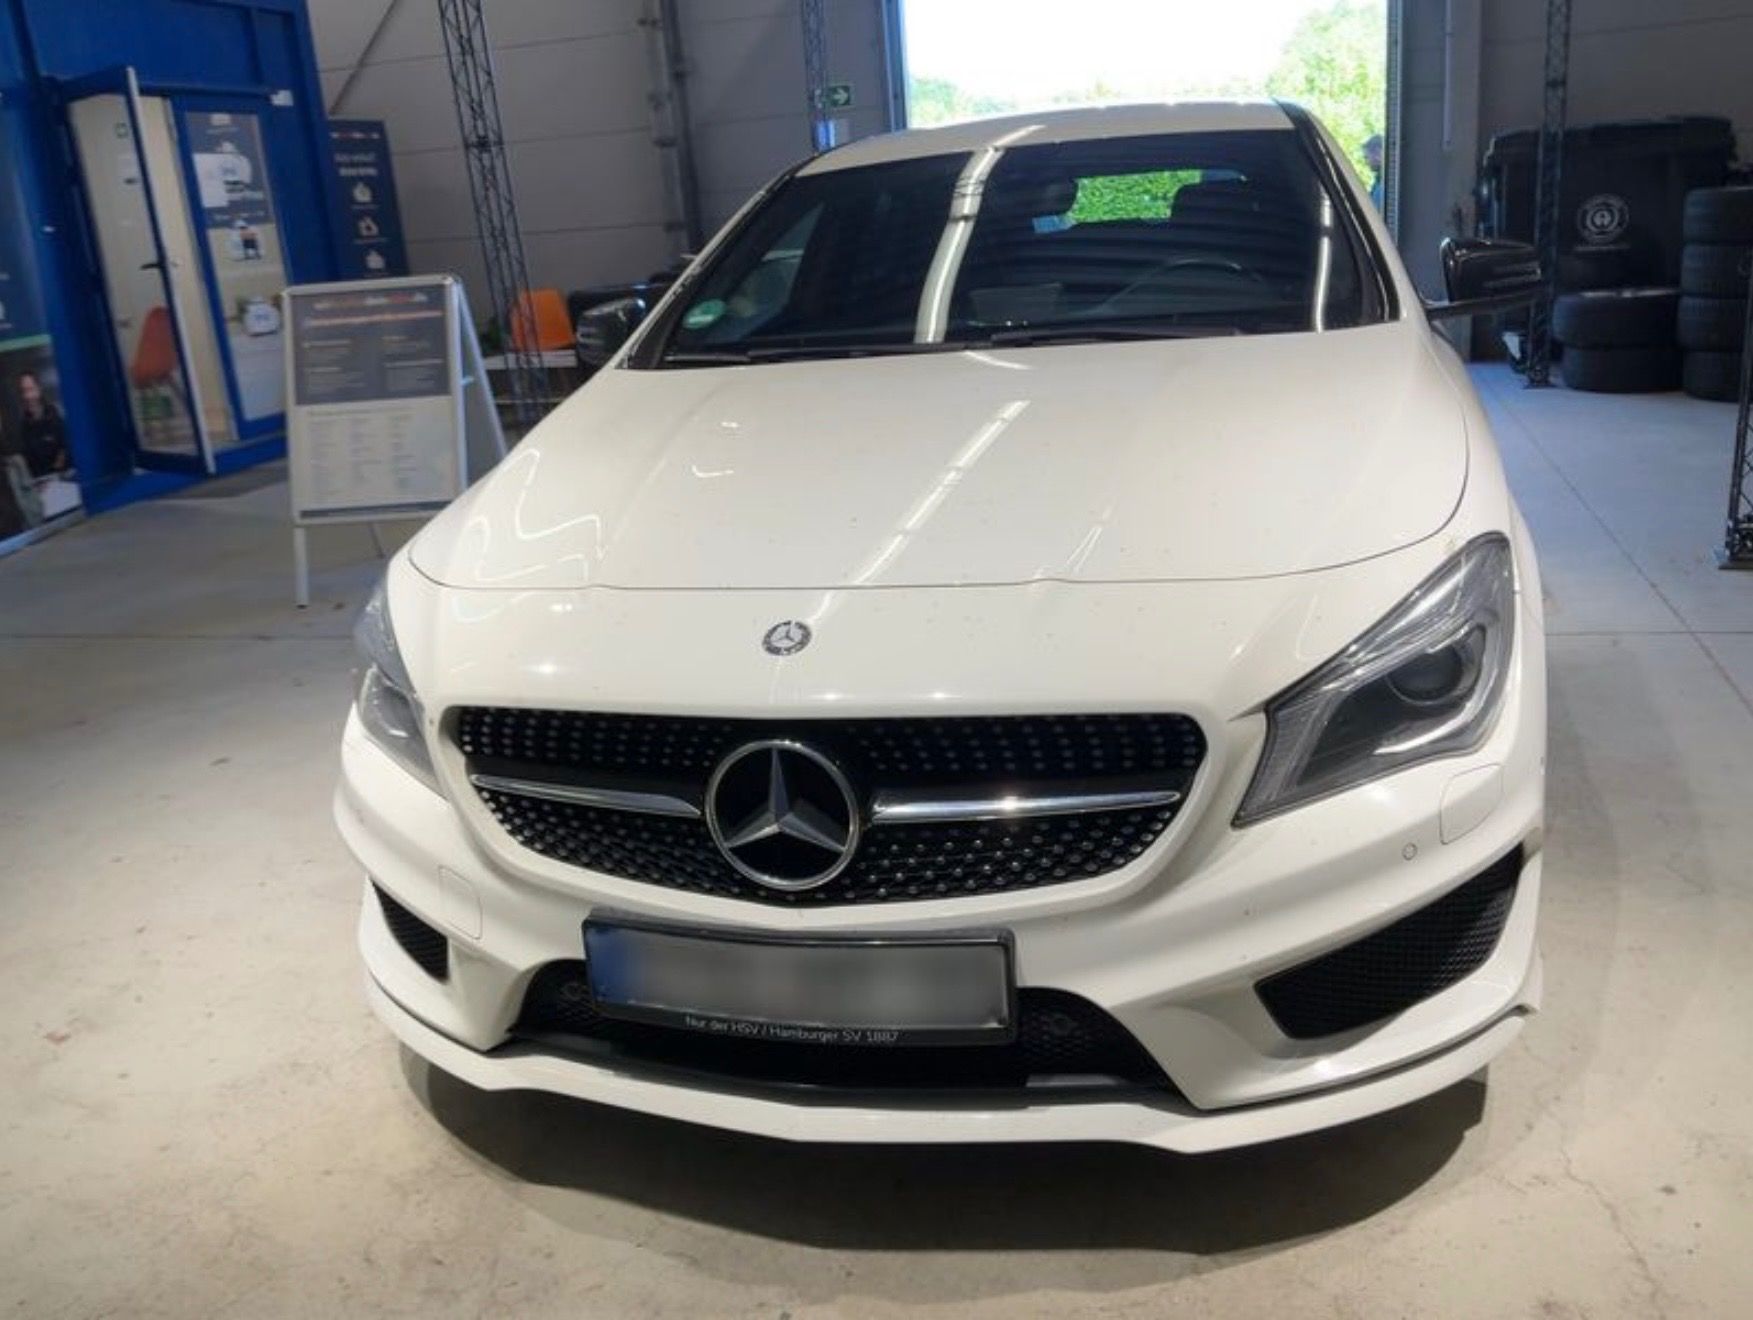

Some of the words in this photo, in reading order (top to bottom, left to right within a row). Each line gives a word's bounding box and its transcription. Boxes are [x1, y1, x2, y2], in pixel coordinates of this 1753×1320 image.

[686, 1015, 706, 1028] Nur
[711, 1019, 728, 1031] der
[731, 1022, 759, 1035] HSV
[770, 1025, 838, 1043] Hamburger
[842, 1031, 861, 1041] SV
[867, 1031, 899, 1042] 1887
